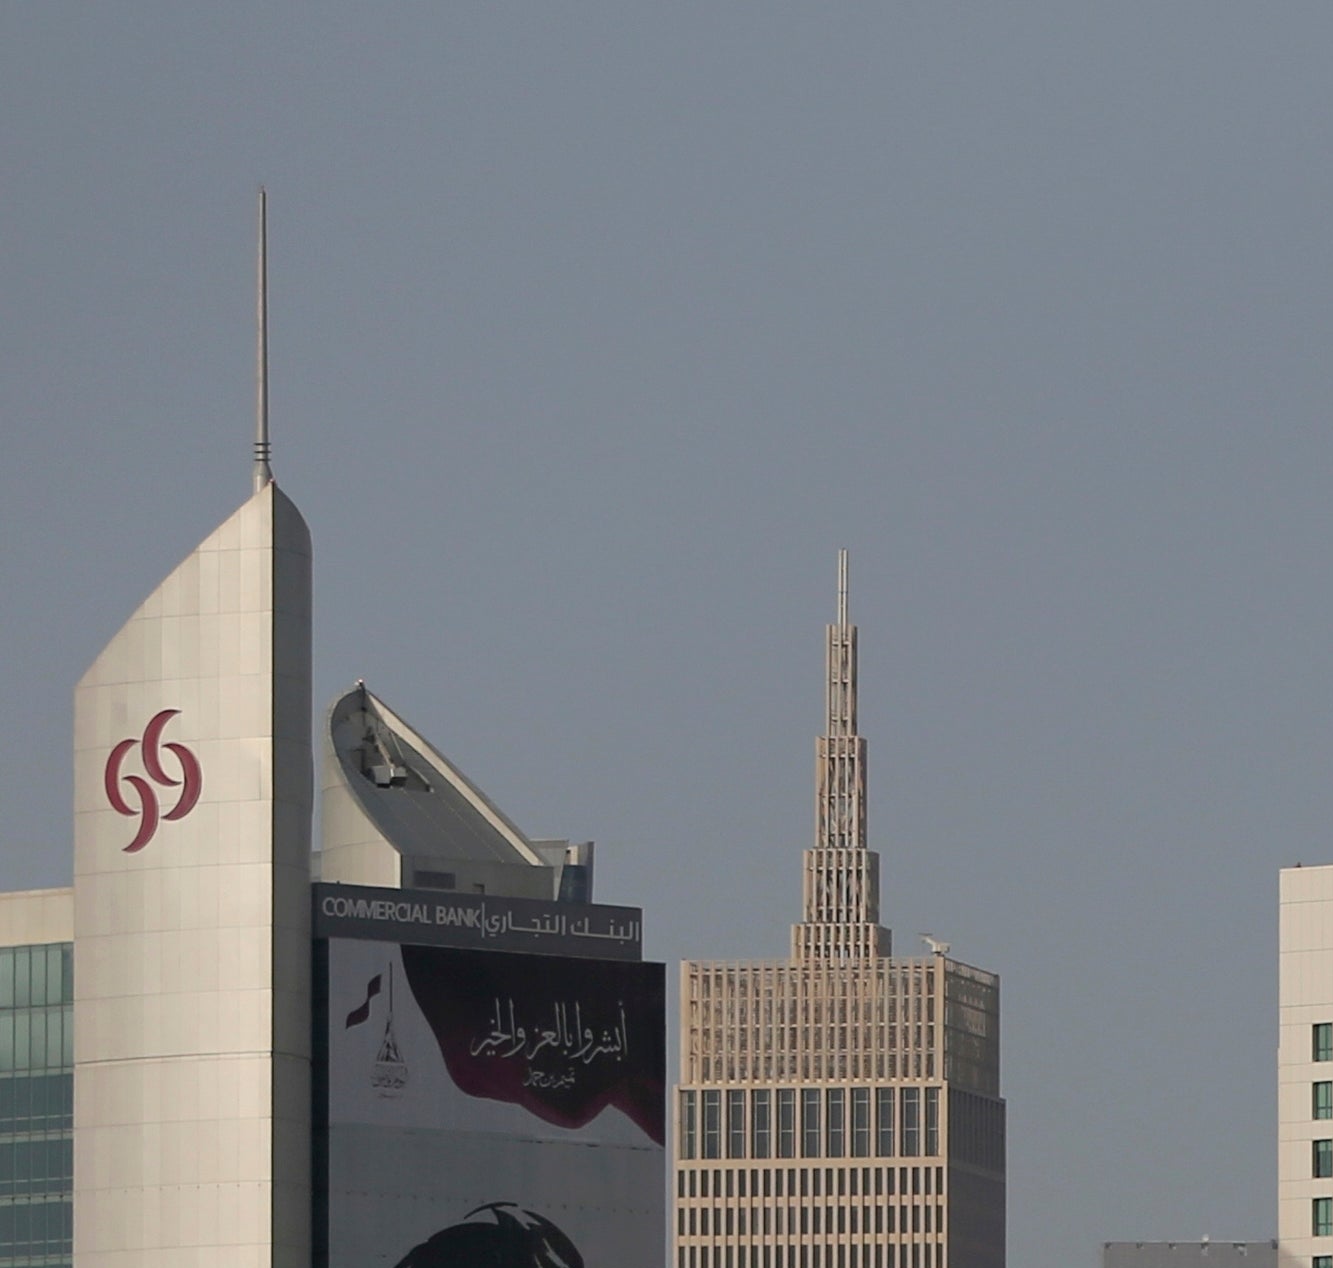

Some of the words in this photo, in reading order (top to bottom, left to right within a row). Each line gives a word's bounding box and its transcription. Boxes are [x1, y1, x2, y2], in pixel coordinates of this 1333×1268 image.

[322, 897, 432, 925] COMMERCIAL
[435, 905, 481, 929] BANK
[484, 911, 567, 938] التجاري
[570, 917, 640, 945] البنك
[569, 1000, 628, 1064] أبشروا
